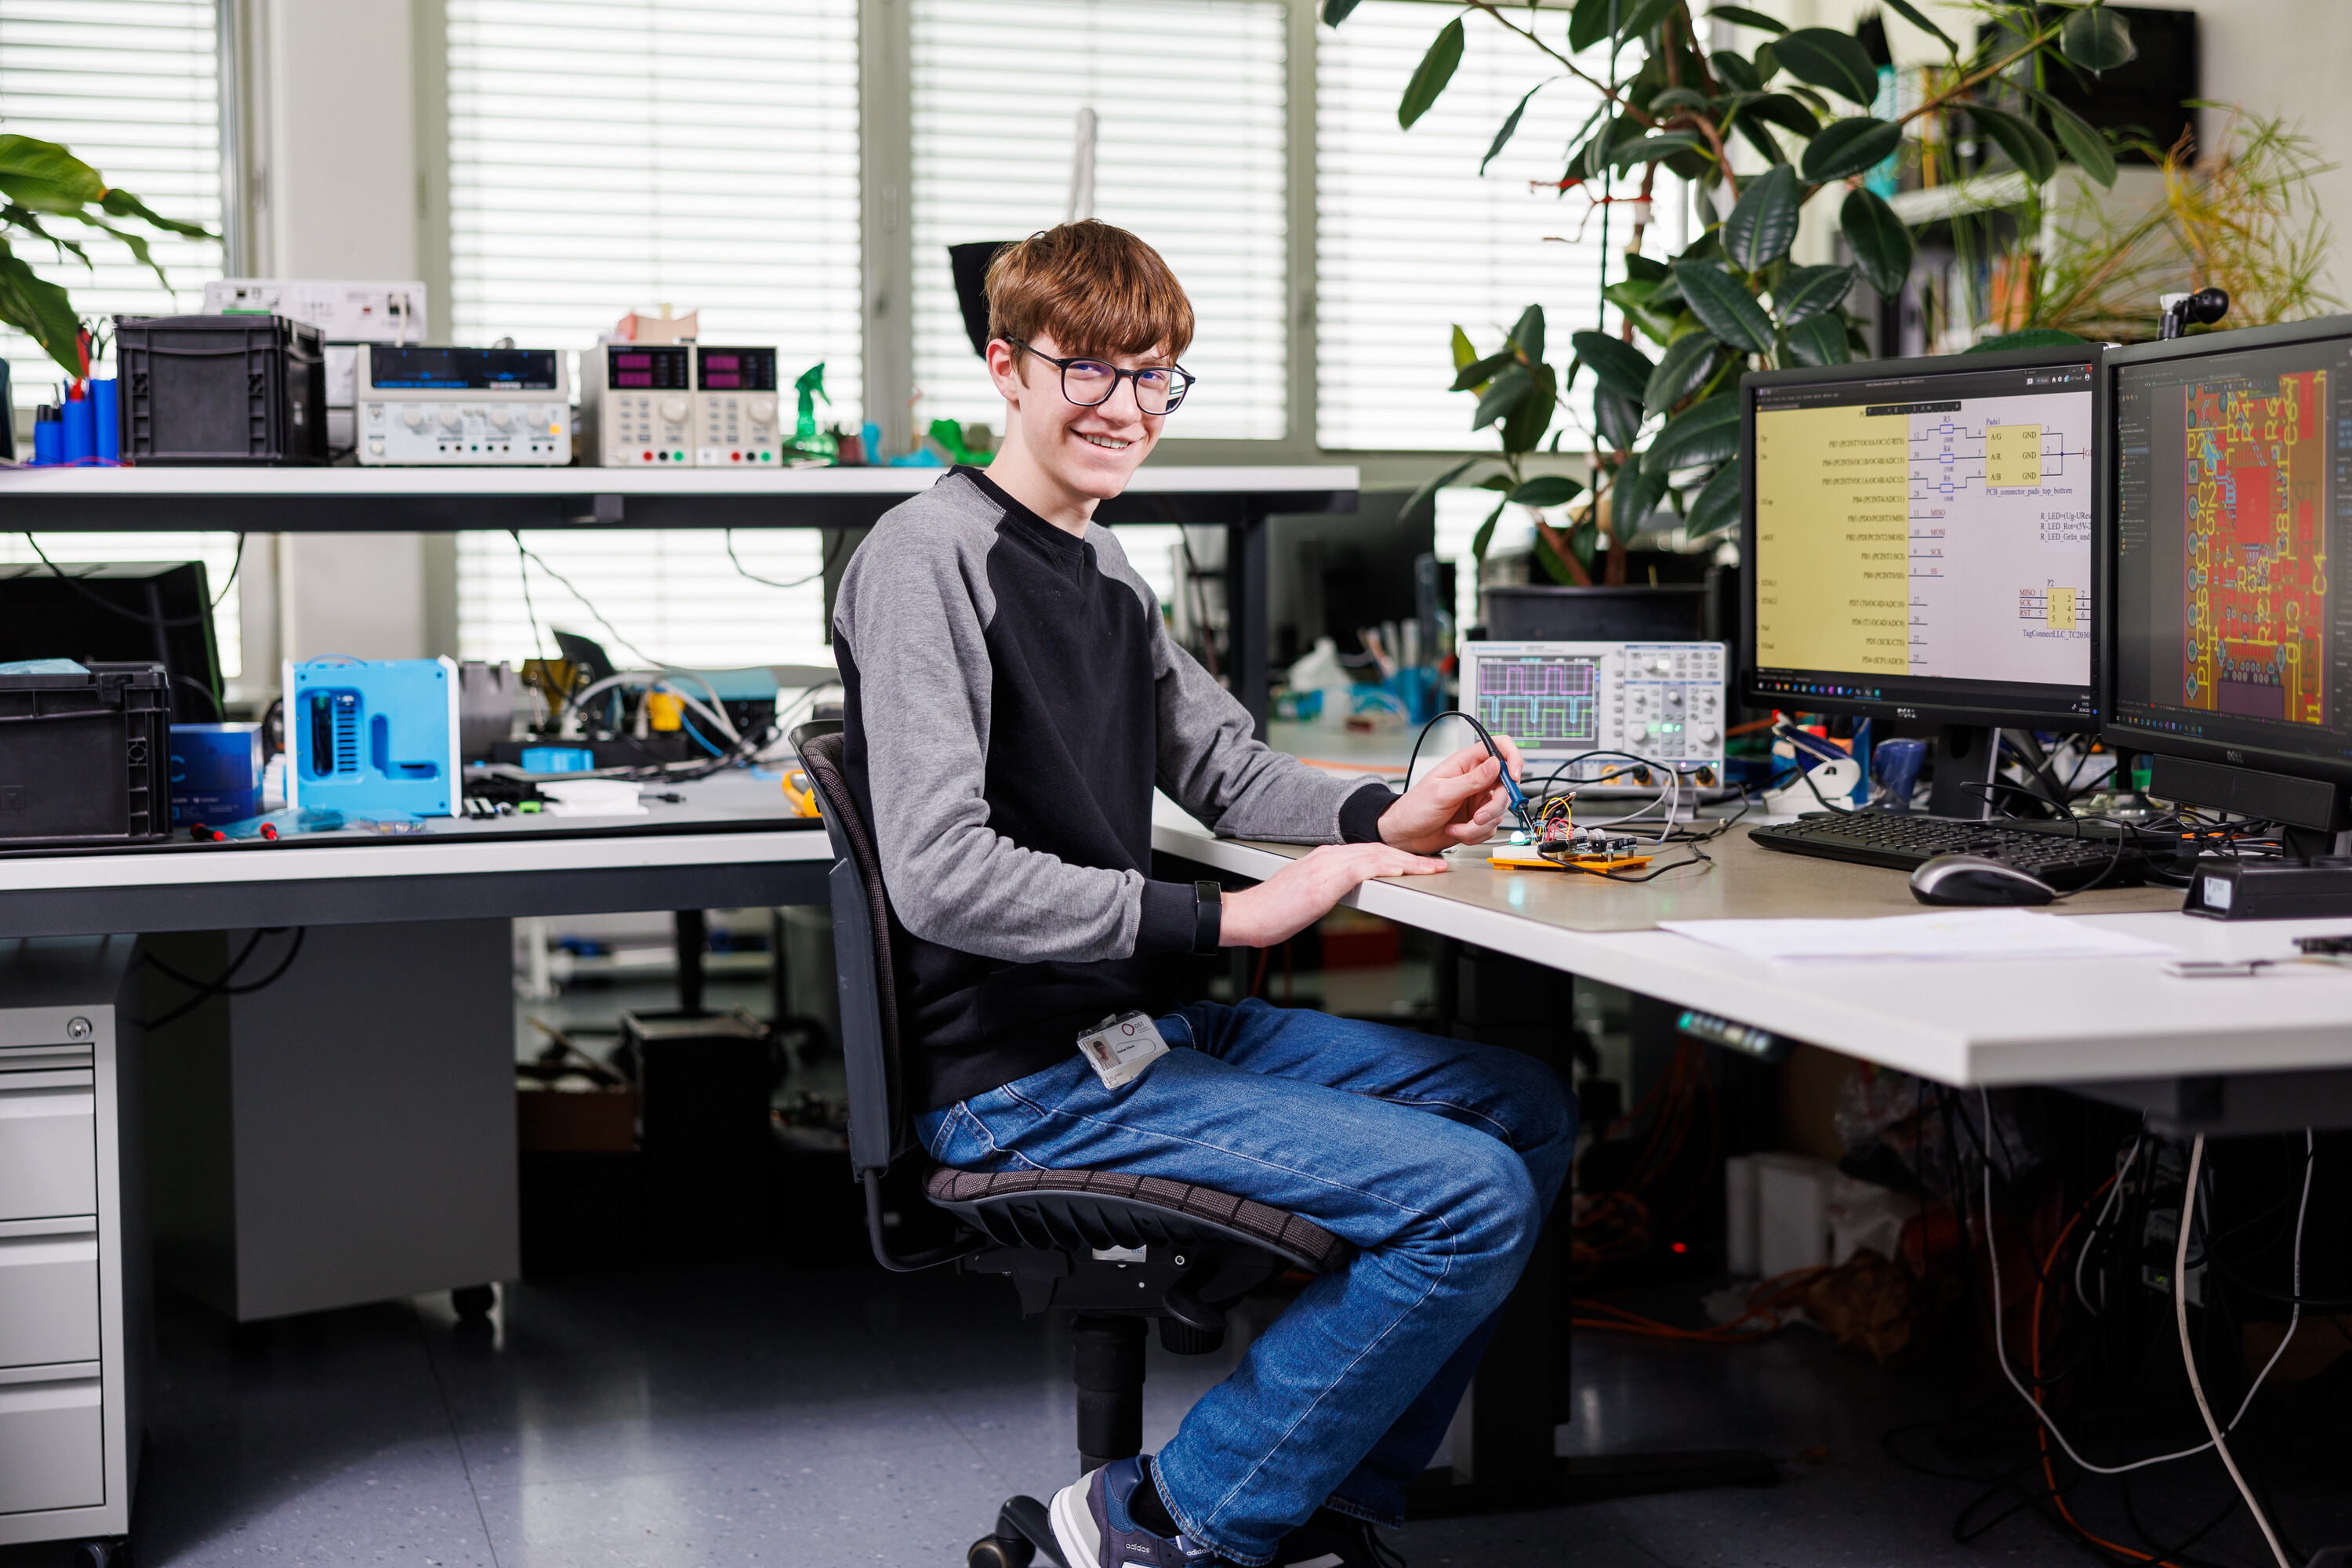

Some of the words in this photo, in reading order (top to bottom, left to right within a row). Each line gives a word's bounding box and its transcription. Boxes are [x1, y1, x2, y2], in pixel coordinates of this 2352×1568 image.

[2187, 432, 2205, 459] P2
[1986, 487, 2073, 497] PCB_connector_pads_top_bottom
[2198, 481, 2218, 508] C2
[2196, 509, 2216, 535] C5
[2314, 551, 2327, 596] C4
[2023, 629, 2090, 641] TagConnectLLC_TC2030
[1125, 1543, 1150, 1554] adidas
[1186, 1548, 1211, 1556] adidas
